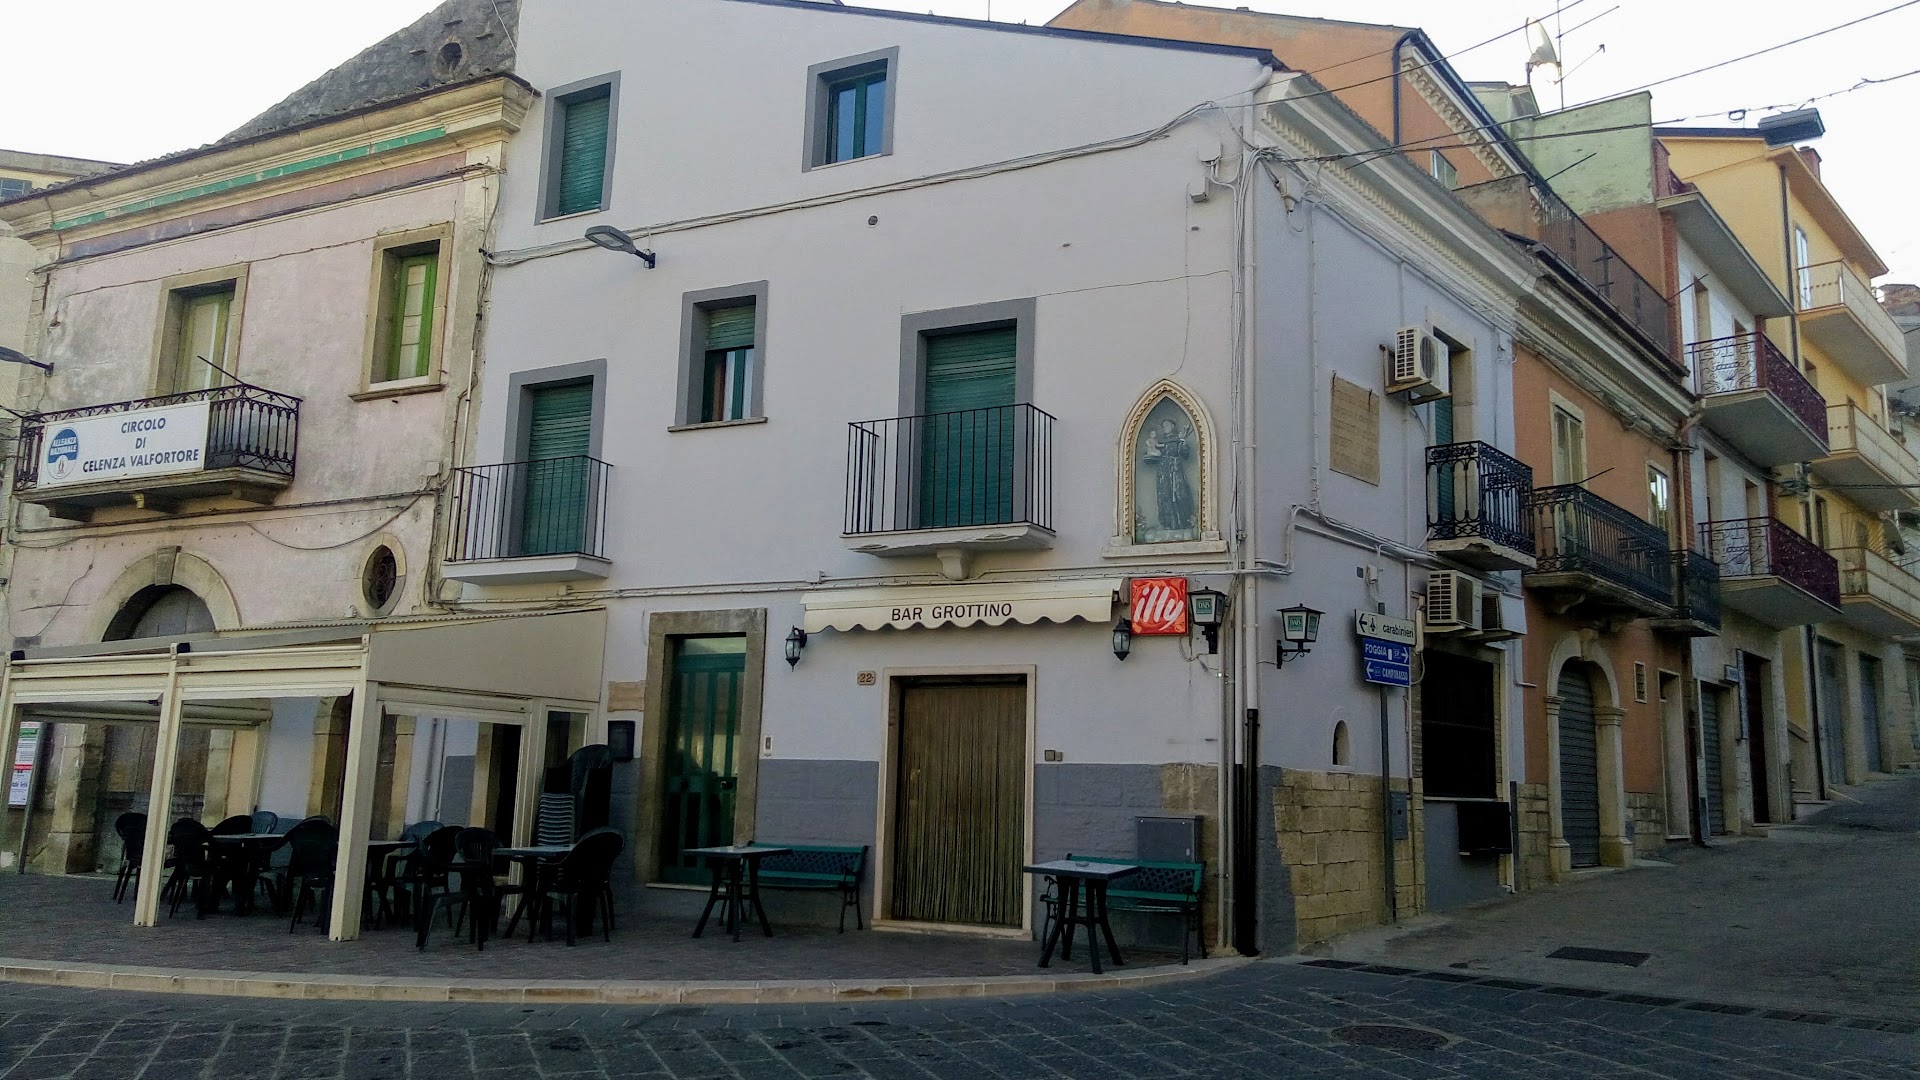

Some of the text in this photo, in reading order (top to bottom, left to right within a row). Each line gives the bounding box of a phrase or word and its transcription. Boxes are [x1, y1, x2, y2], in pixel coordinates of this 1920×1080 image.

[121, 417, 166, 434] CIRCOLO
[135, 437, 147, 449] DI
[82, 449, 199, 473] CELENZA VALFORTORE
[891, 603, 1012, 621] BAR GROTTINO
[1133, 585, 1184, 631] illy
[1382, 623, 1414, 638] carabinieri
[1365, 643, 1387, 657] FOGGIA
[859, 672, 873, 683] 22
